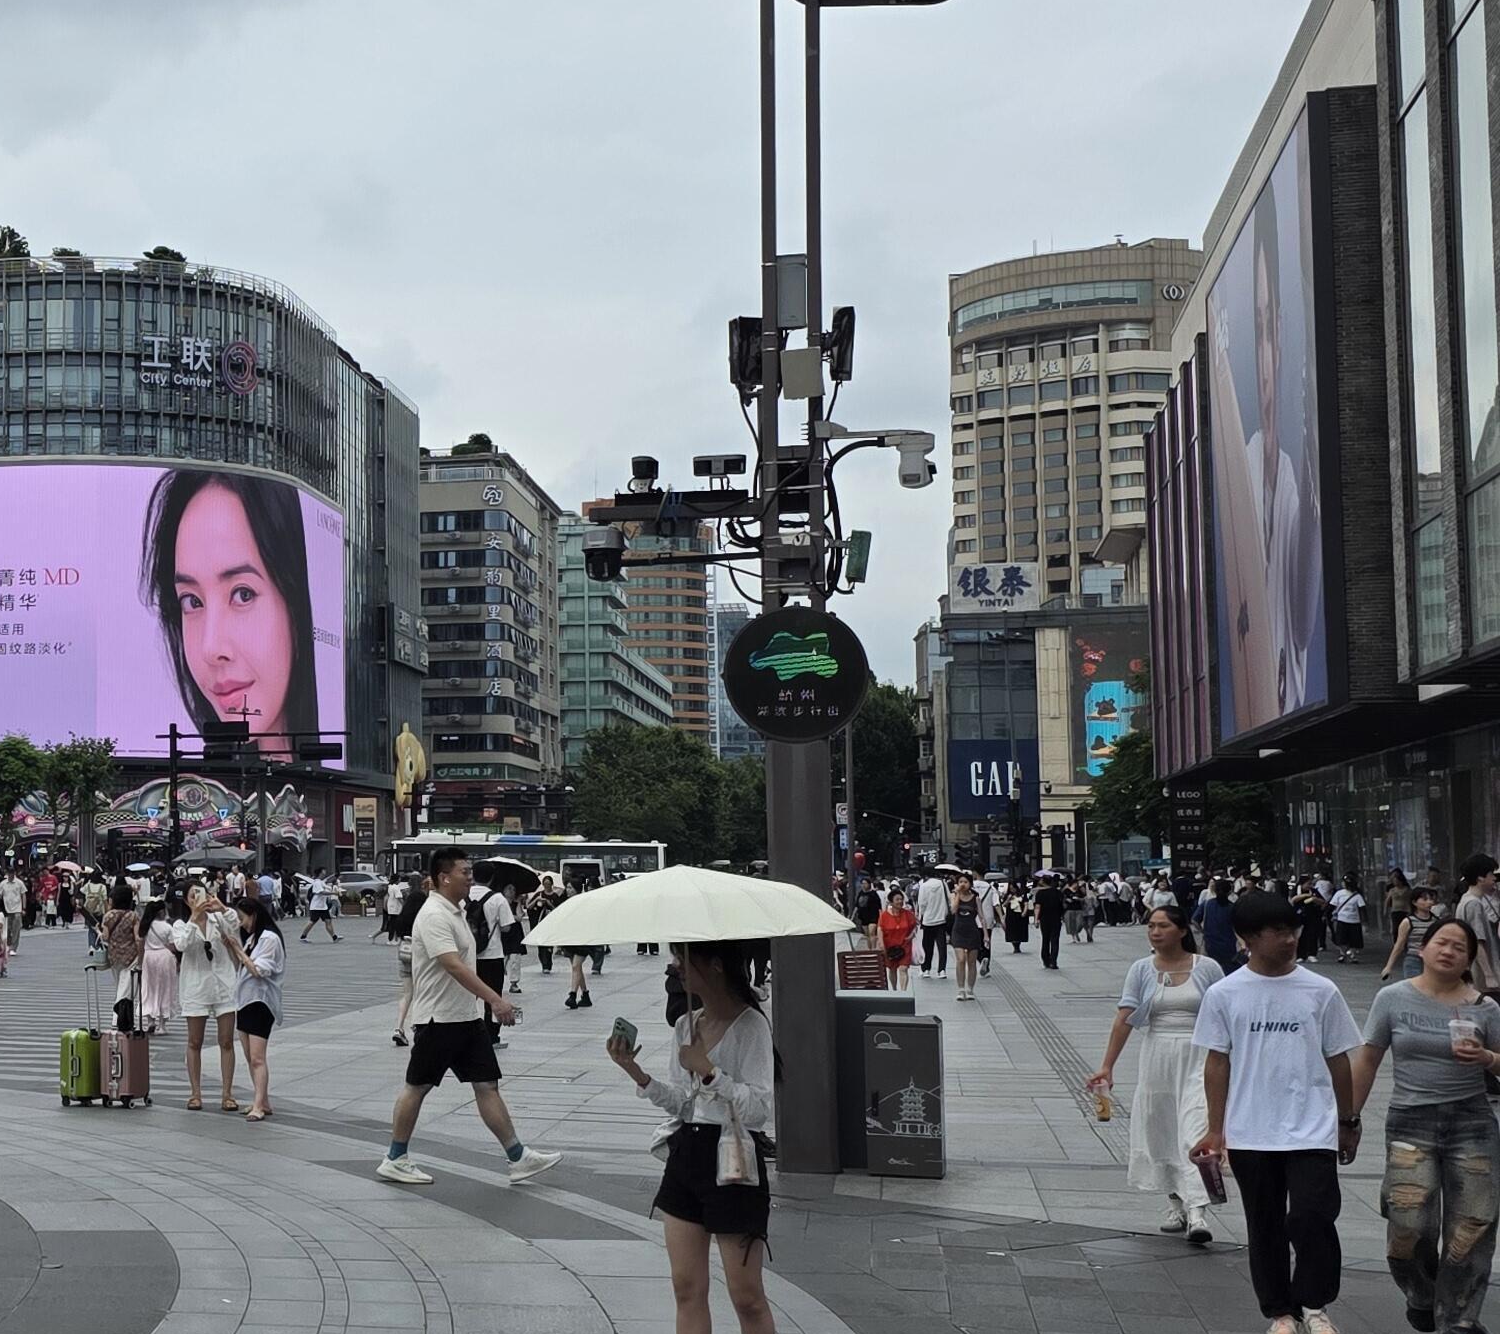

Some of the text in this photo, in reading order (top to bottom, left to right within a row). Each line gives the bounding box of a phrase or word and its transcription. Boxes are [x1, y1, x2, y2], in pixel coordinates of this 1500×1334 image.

[141, 336, 212, 372] 工联
[142, 371, 212, 387] City Center
[43, 568, 80, 586] MD
[956, 566, 1032, 598] 银泰
[978, 598, 1014, 607] YINTAI
[1176, 791, 1201, 799] LEGO
[1250, 1021, 1300, 1033] LI-NING
